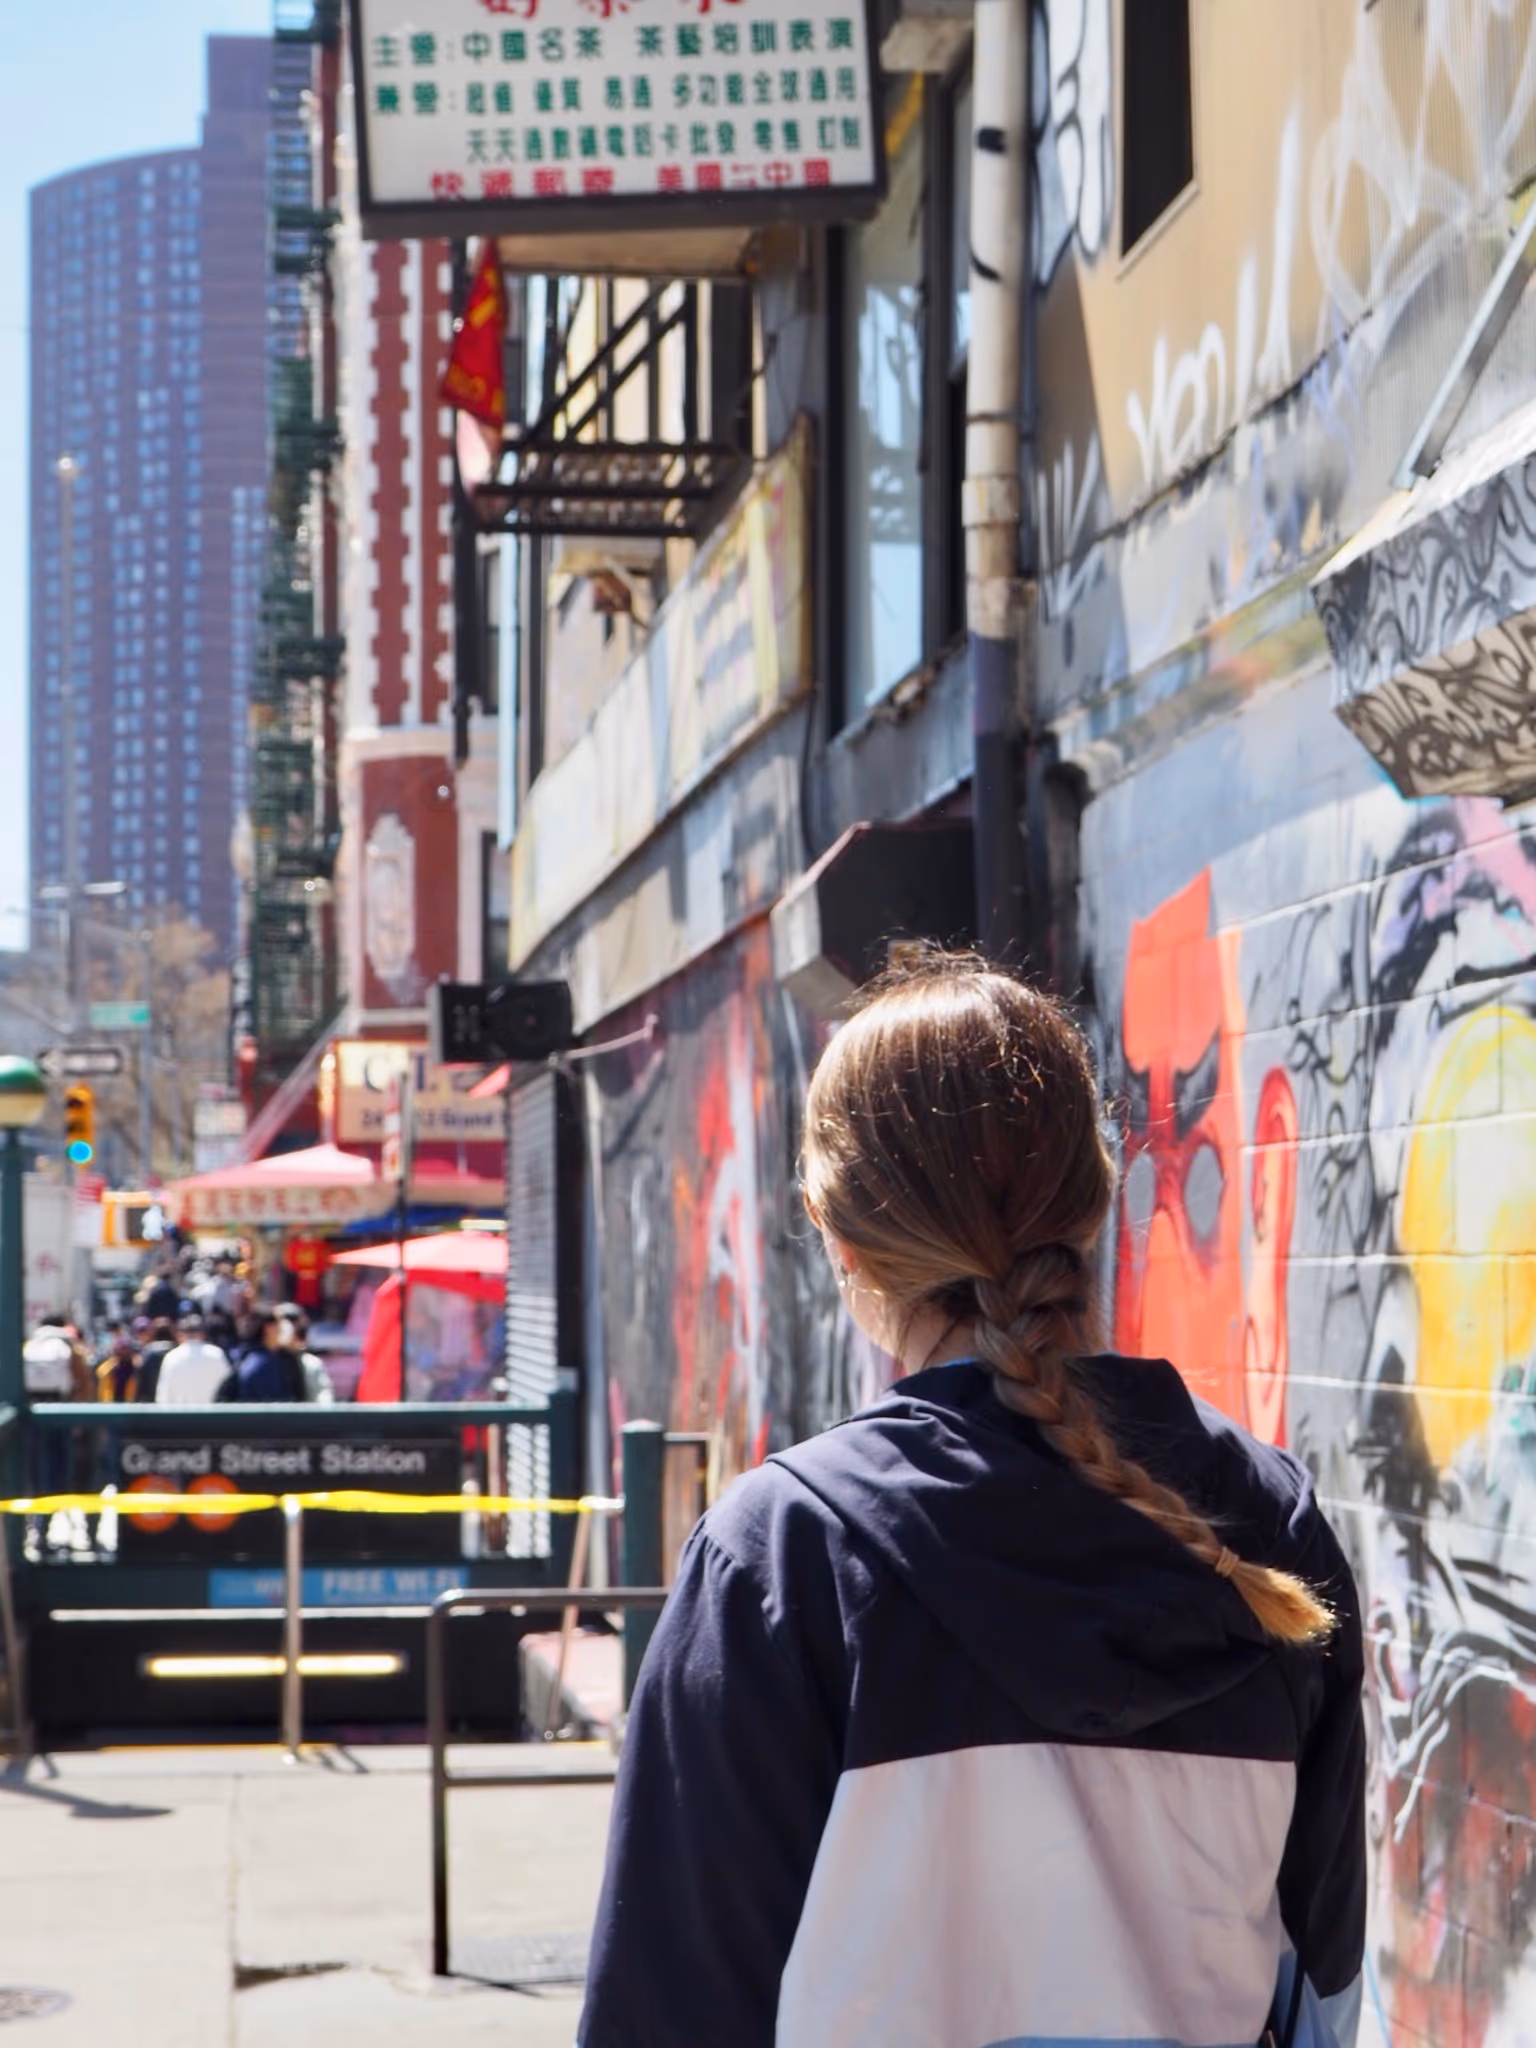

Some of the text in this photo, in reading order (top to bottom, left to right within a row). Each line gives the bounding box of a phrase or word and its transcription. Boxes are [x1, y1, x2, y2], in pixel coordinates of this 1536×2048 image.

[121, 1443, 426, 1475] Grand Street Station
